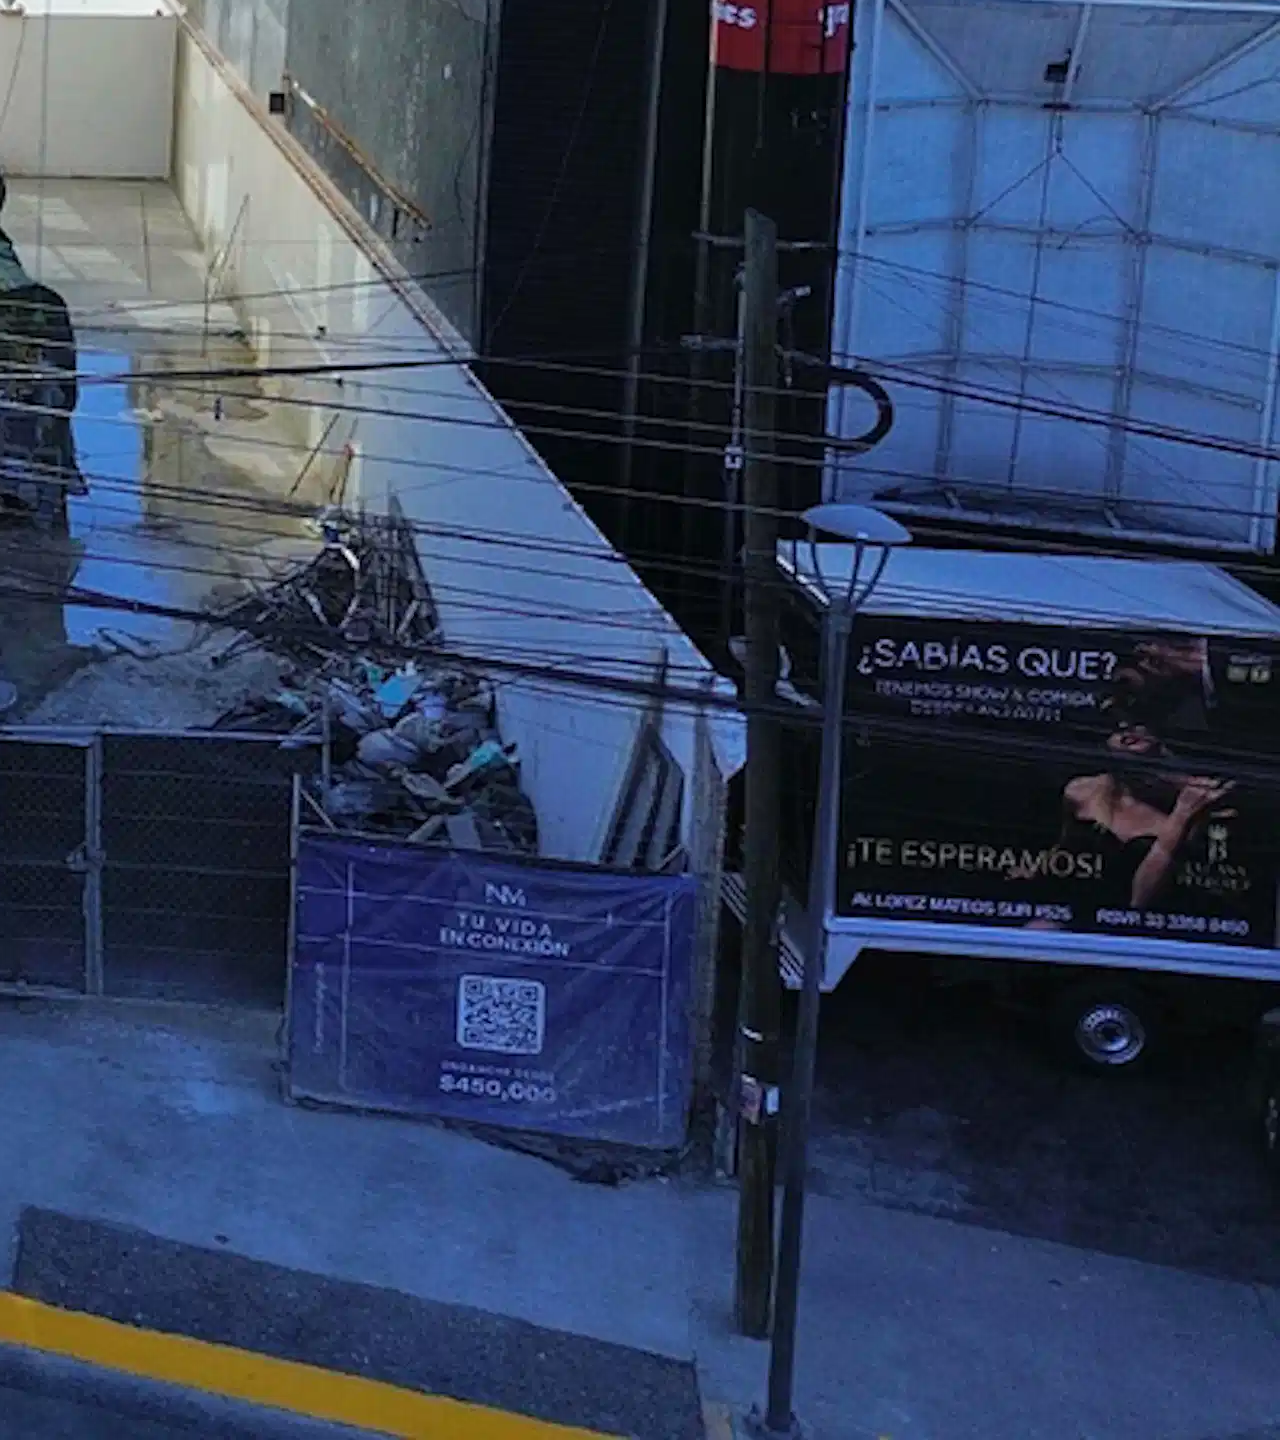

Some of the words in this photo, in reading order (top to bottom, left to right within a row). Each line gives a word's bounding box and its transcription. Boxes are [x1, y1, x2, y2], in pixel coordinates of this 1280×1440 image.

[856, 636, 1010, 677] ¿SABÍAS
[1017, 646, 1119, 681] QUE?
[847, 837, 897, 868] ¡TE
[900, 840, 1105, 880] ESPERAMOS!
[457, 912, 485, 931] TU
[497, 916, 552, 937] VIDA
[439, 1073, 558, 1103] $450,000
